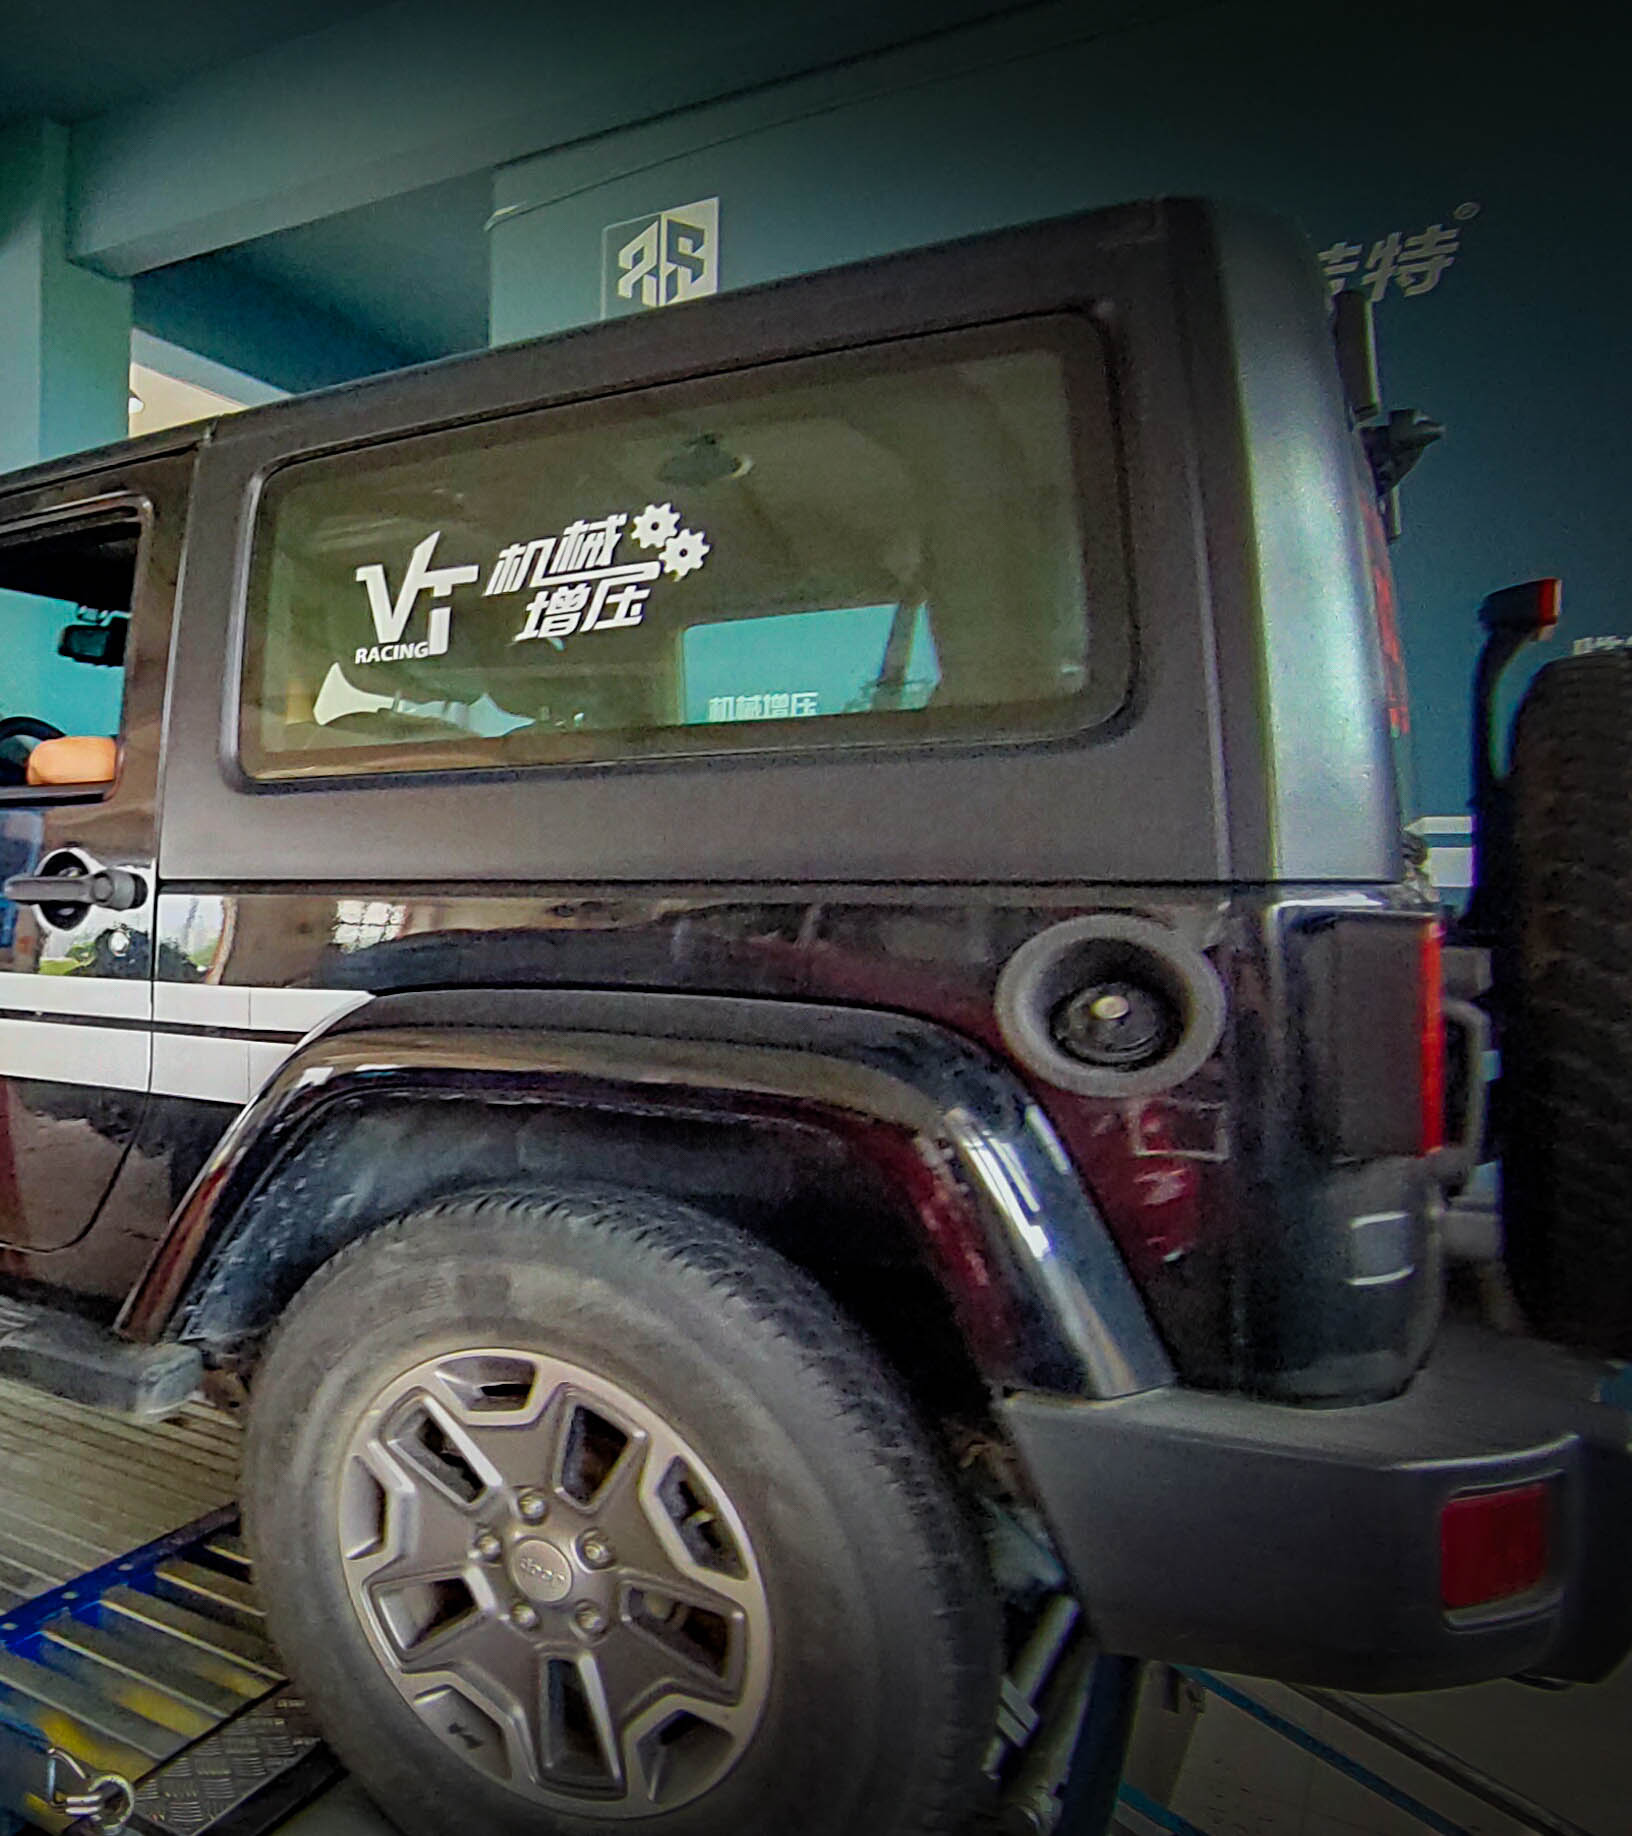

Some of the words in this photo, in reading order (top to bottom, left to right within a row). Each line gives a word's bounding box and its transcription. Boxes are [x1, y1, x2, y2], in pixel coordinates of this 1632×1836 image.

[482, 513, 660, 597] 机械
[514, 578, 652, 643] 增压
[354, 641, 430, 665] RACING
[707, 691, 819, 722] 机械增压
